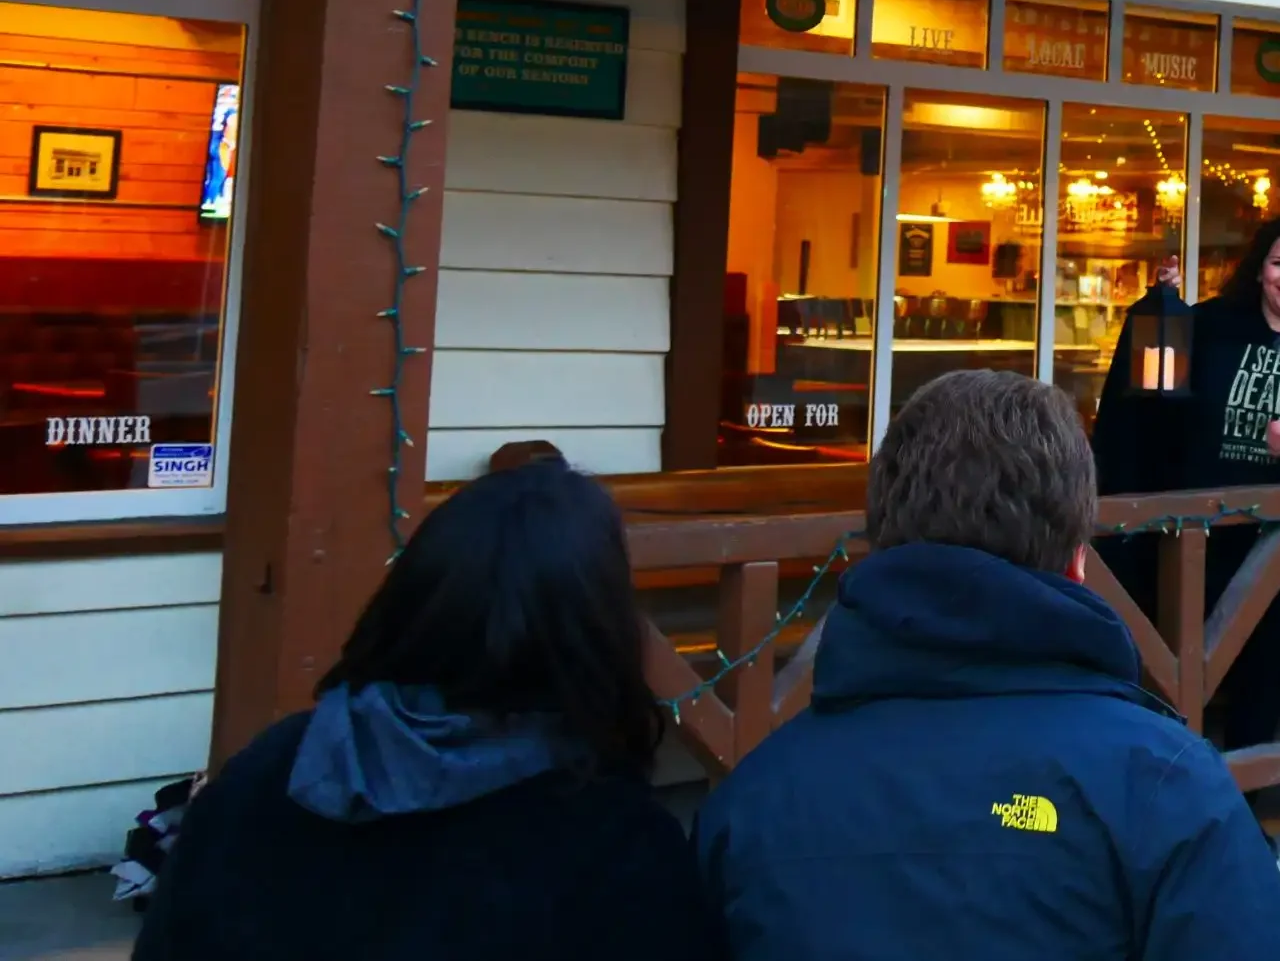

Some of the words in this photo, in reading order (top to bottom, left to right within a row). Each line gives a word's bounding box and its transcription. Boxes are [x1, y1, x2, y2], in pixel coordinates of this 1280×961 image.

[910, 25, 954, 54] LIVE
[1027, 33, 1085, 69] LOCAL
[1144, 52, 1197, 81] MUSIC
[1240, 343, 1252, 369] I
[747, 403, 796, 428] OPEN
[804, 403, 840, 427] FOR
[45, 415, 152, 446] DINNER
[154, 459, 209, 473] SINGH
[991, 802, 1037, 819] NORTH
[1013, 793, 1038, 808] THE
[1001, 815, 1034, 830] FACE
